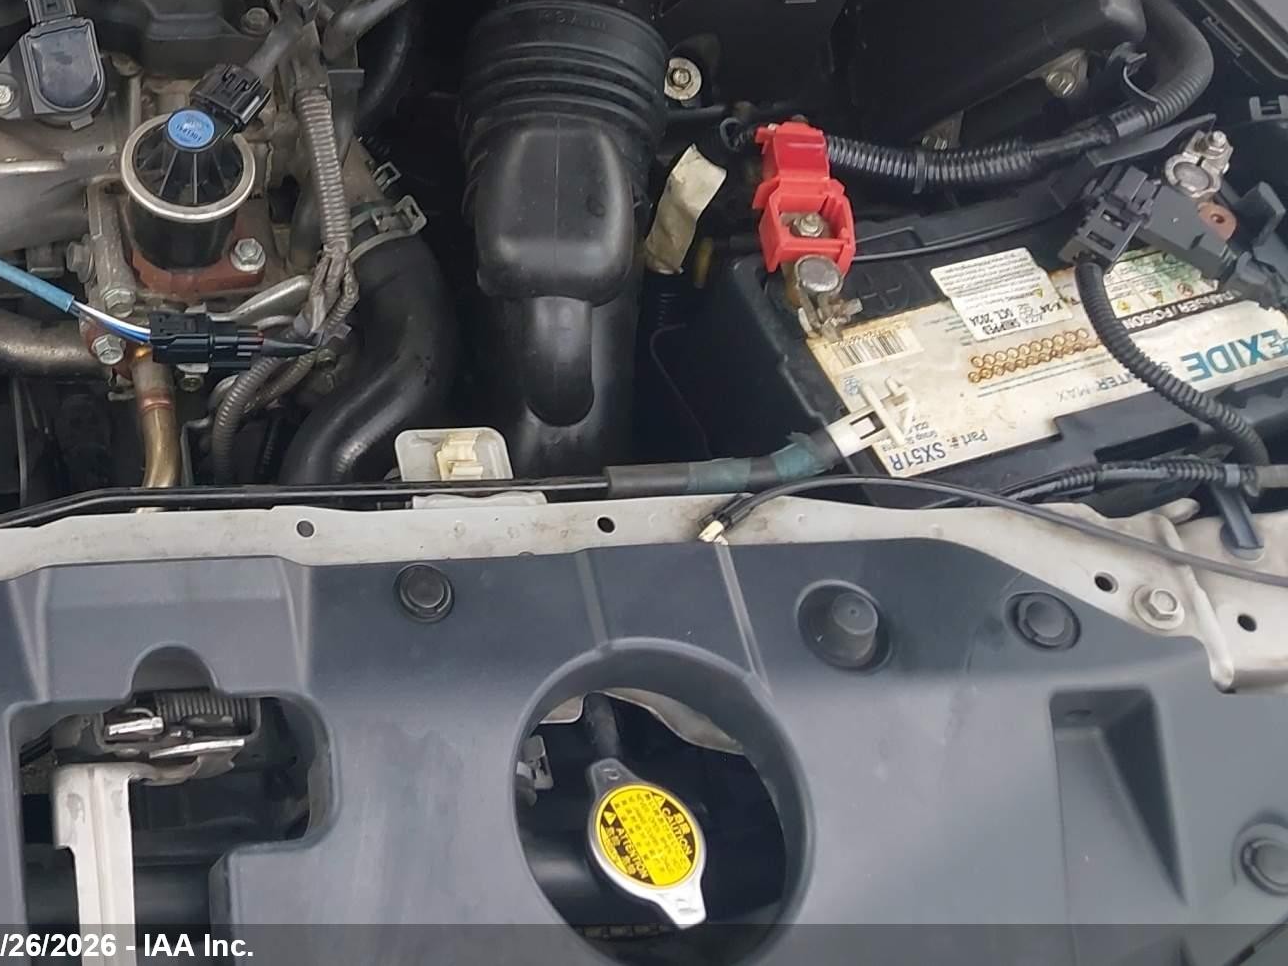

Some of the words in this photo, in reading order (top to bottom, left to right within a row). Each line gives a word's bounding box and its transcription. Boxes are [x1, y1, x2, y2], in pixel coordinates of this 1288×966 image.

[1180, 329, 1288, 382] EXIDE
[889, 442, 947, 471] SX51R
[960, 430, 989, 445] Part
[615, 827, 649, 879] ATTENTION
[662, 807, 693, 855] CAUTION
